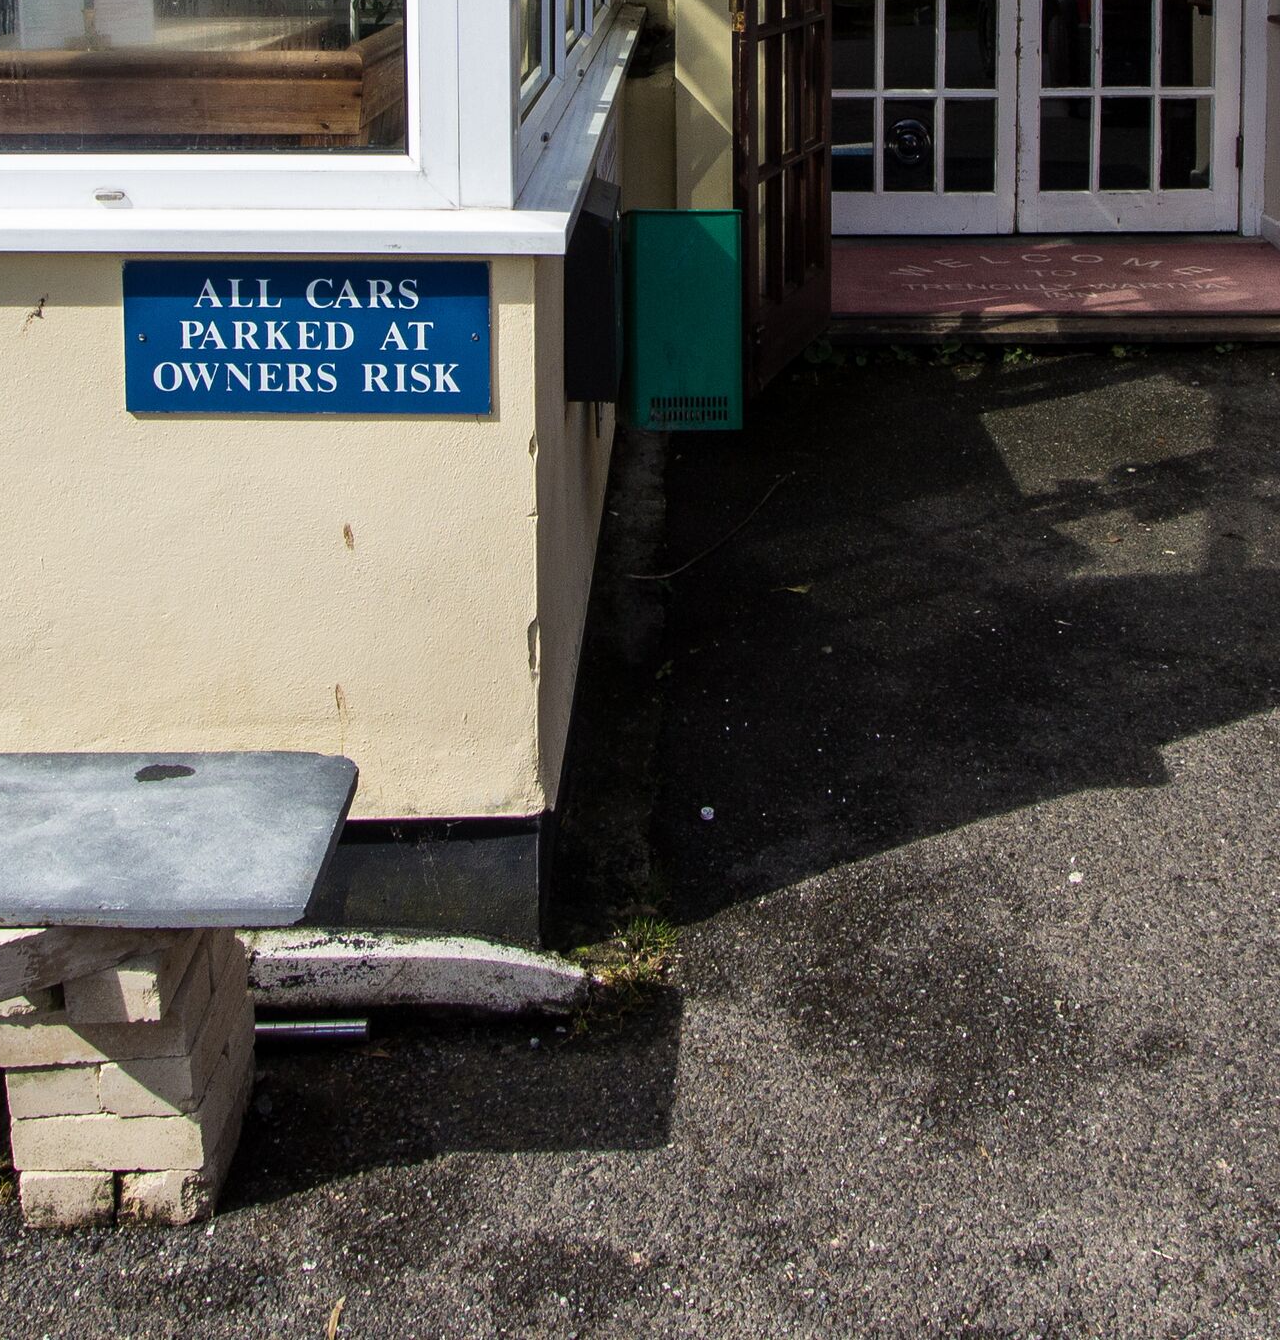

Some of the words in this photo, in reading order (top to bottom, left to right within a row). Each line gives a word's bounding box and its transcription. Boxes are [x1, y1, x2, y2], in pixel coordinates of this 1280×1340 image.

[889, 253, 1214, 277] WELCOME
[193, 278, 282, 309] ALL
[305, 278, 420, 310] CARS
[901, 283, 1072, 291] TRENGILLY
[179, 320, 355, 350] PARKED
[379, 321, 434, 351] AT
[152, 361, 337, 393] OWNERS
[361, 363, 461, 393] RISK
